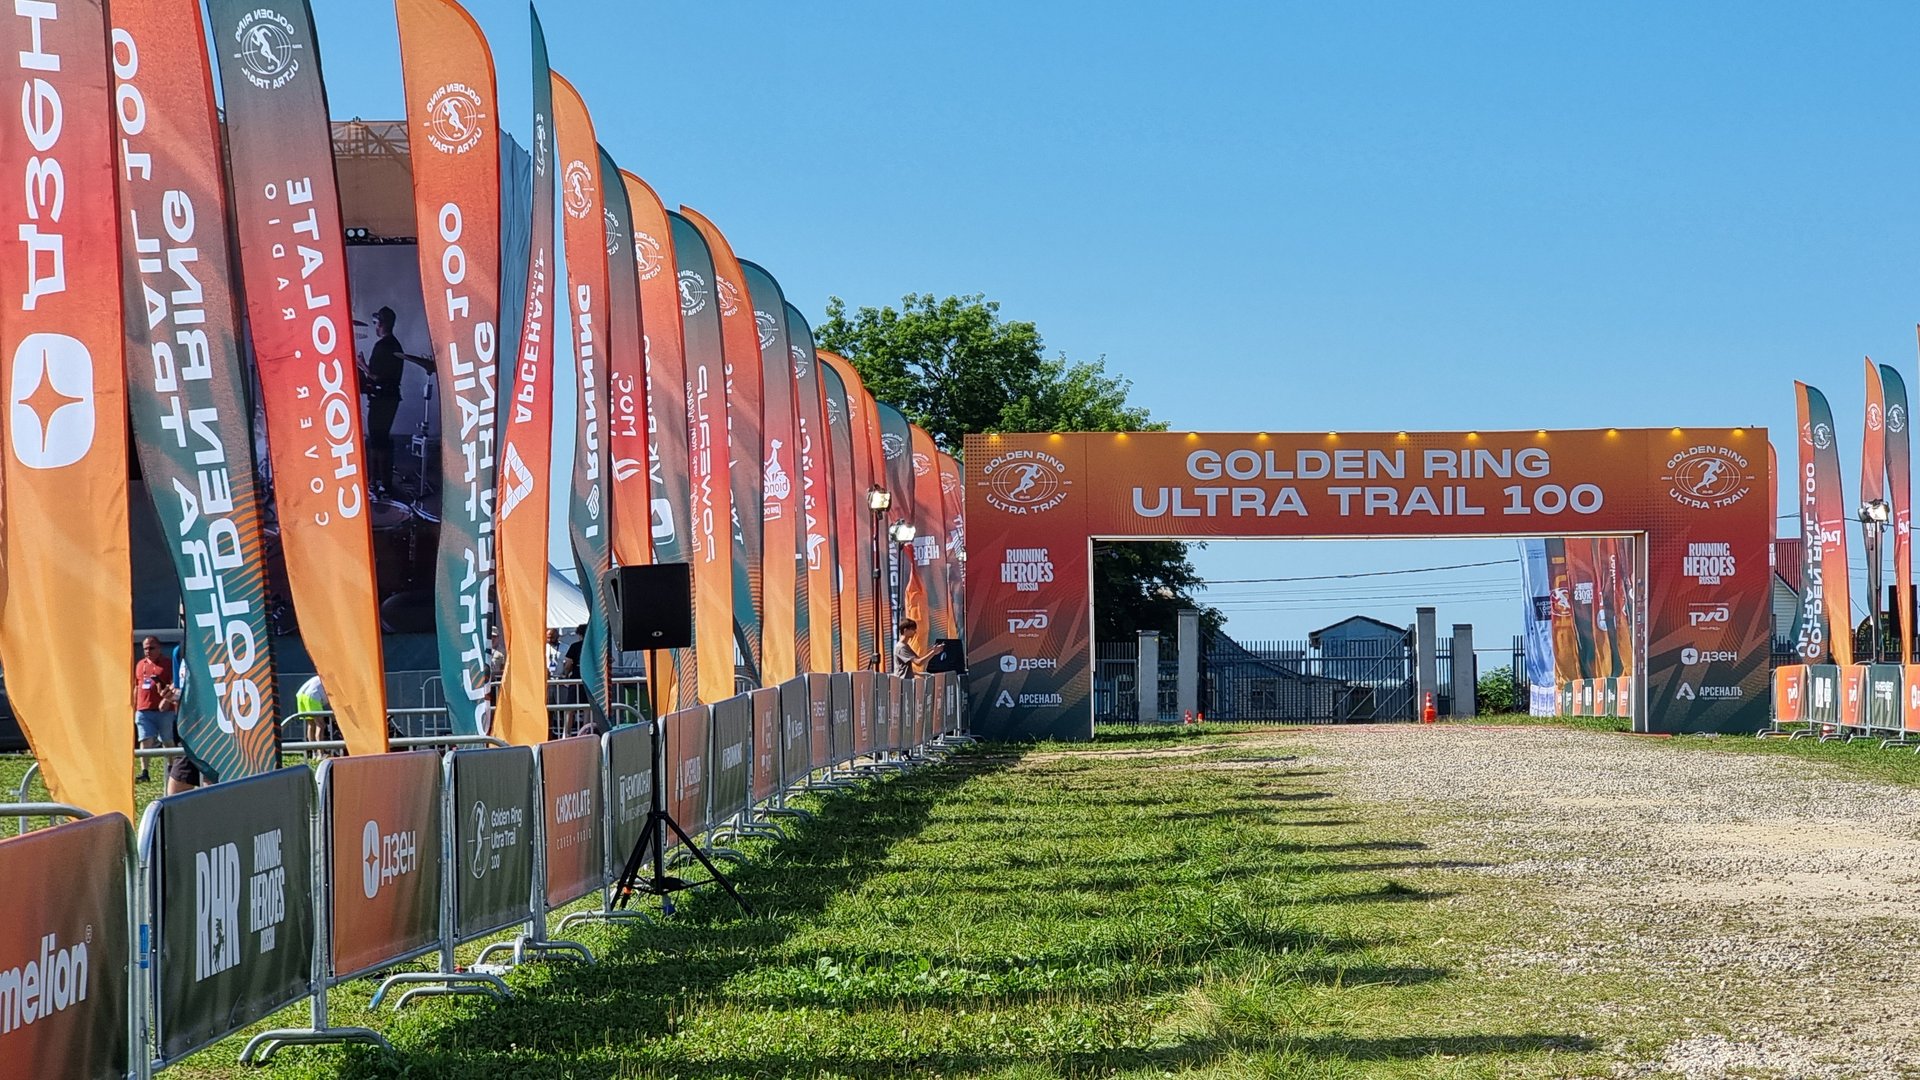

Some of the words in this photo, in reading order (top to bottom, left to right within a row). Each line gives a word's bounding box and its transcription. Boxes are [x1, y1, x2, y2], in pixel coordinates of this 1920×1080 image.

[984, 450, 1034, 474] GOLDEN
[1036, 451, 1066, 473] RING
[1186, 448, 1404, 481] GOLDEN
[1424, 447, 1550, 478] RING
[1667, 445, 1716, 469] GOLDEN
[1718, 446, 1748, 468] RING
[986, 493, 1027, 515] ULTRA
[1031, 491, 1068, 514] TRAIL
[1133, 486, 1308, 518] ULTRA
[1327, 486, 1485, 517] TRAIL
[1503, 482, 1604, 516] 100
[1669, 488, 1710, 509] ULTRA
[1713, 486, 1750, 508] TRAIL
[1006, 548, 1048, 562] RUNNING
[1688, 542, 1730, 556] RUNNING
[1001, 562, 1054, 583] HEROES
[1683, 556, 1736, 576] HEROES
[1019, 693, 1063, 704] АРСЕНАЛЪ
[1699, 686, 1743, 697] АРСЕНАЛЪ
[491, 807, 510, 828] Golden
[511, 805, 522, 828] Ring
[556, 789, 591, 825] CHOCOLATE
[254, 828, 282, 873] RUNNING
[250, 866, 286, 934] HEROES
[196, 842, 241, 983] RHR
[0, 932, 88, 1034] melion
